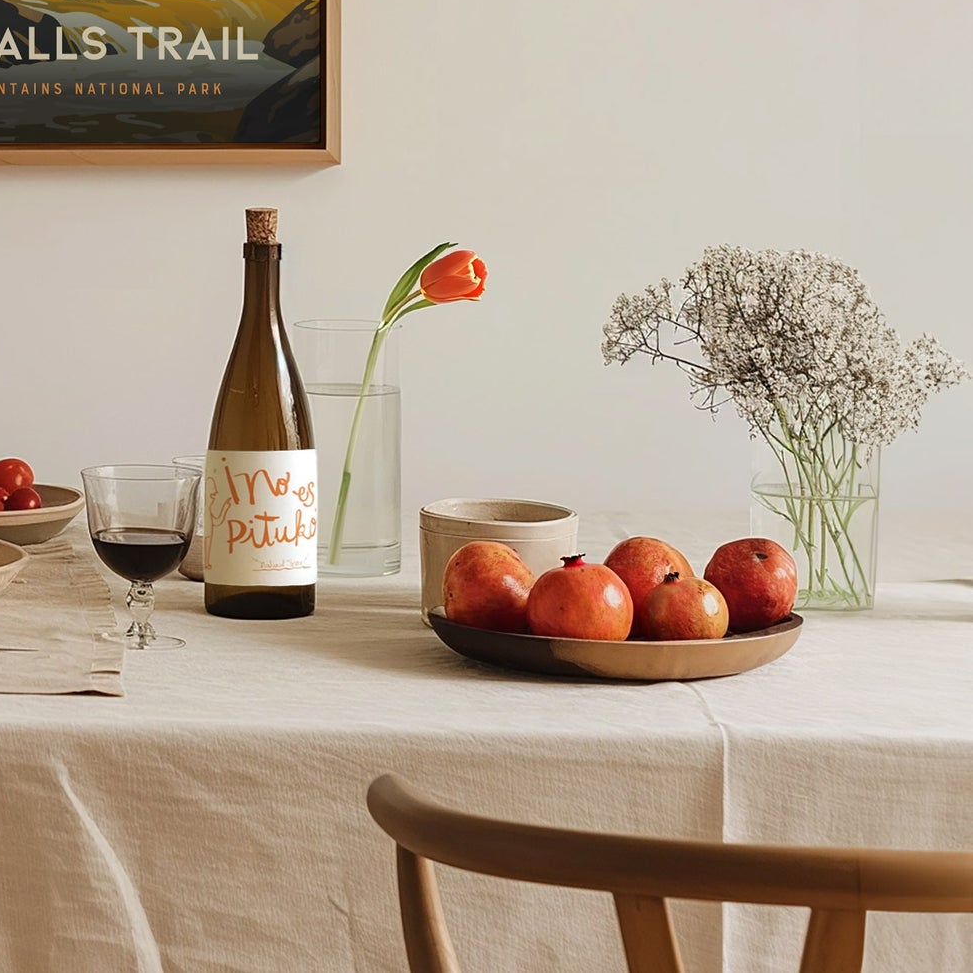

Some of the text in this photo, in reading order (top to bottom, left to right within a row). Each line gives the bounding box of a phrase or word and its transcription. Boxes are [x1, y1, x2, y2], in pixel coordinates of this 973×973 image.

[127, 25, 259, 61] TRAIL
[74, 82, 165, 95] NATIONAL
[176, 82, 223, 95] PARK
[292, 481, 315, 508] es
